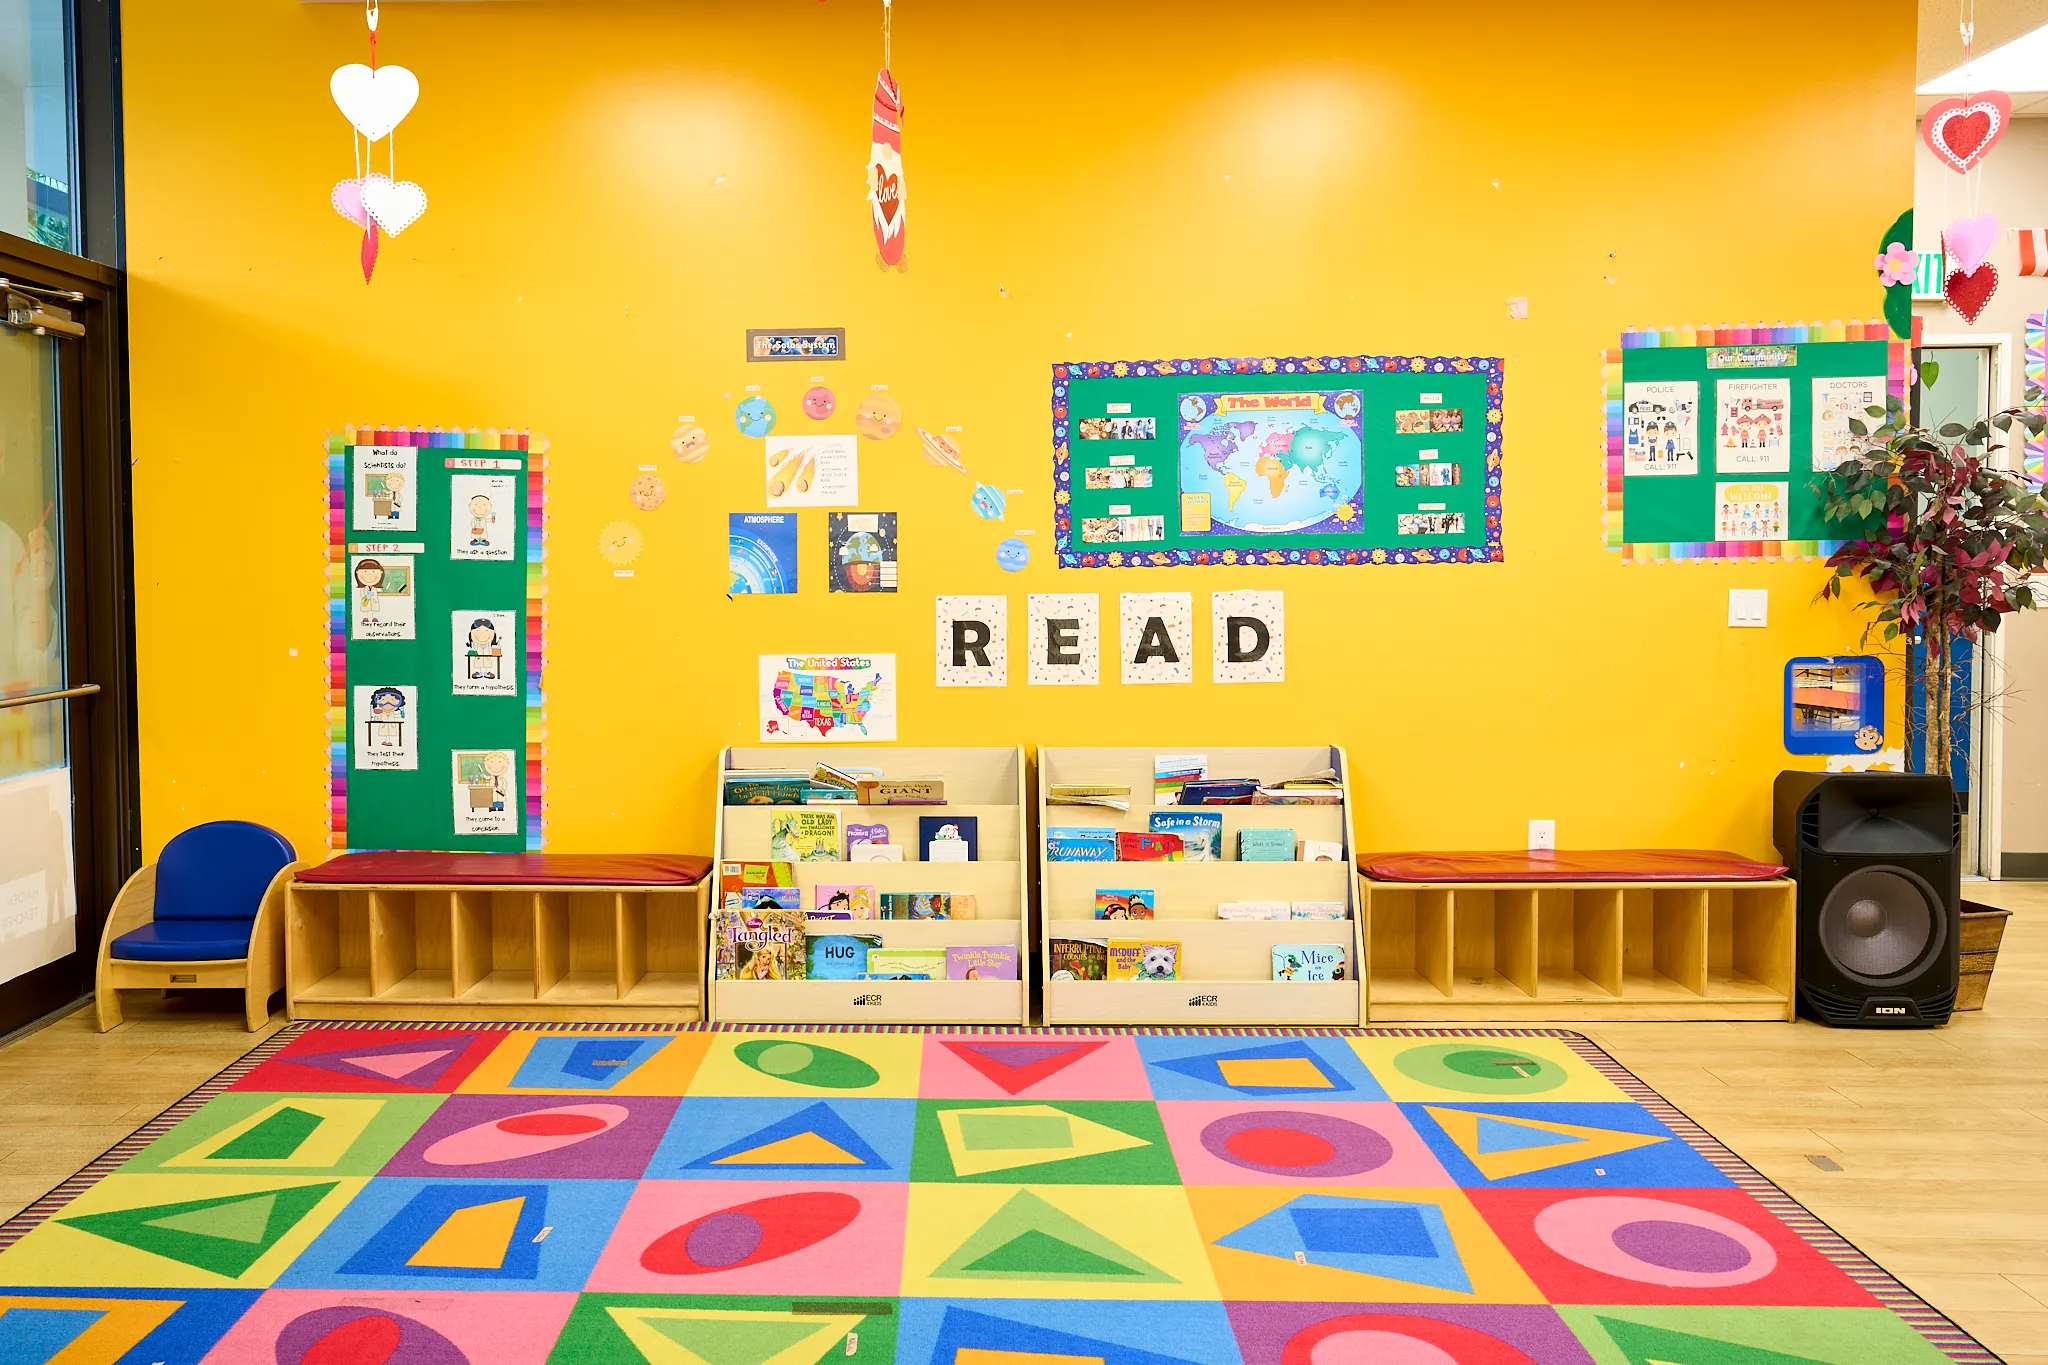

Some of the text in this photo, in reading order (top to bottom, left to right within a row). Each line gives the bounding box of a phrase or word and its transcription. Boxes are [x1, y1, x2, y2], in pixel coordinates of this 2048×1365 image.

[878, 174, 898, 204] love
[1912, 254, 1947, 293] XIT
[756, 340, 836, 351] The Solar System
[1718, 353, 1787, 363] Our Community
[1728, 383, 1778, 391] FIREFIGHTER
[1830, 381, 1868, 389] DOCTORS
[1228, 395, 1311, 409] The World
[460, 459, 501, 469] STEP 1
[1736, 455, 1758, 463] CALL:
[1730, 491, 1772, 501] WELCOME
[743, 515, 785, 524] ATMOSPHERE
[365, 544, 400, 552] STEP 2
[756, 538, 779, 564] EXOSPHERE
[952, 616, 1270, 667] READ
[787, 658, 871, 668] The United States
[813, 717, 832, 727] TEXAS
[1154, 816, 1175, 829] Safe
[1176, 818, 1184, 826] in
[1192, 815, 1221, 828] Storm
[1051, 846, 1108, 858] RUNAWAY
[728, 925, 793, 952] Tangled
[825, 946, 855, 959] HUG
[1301, 950, 1334, 964] Mice
[967, 959, 986, 968] Little
[1307, 970, 1325, 981] Ice
